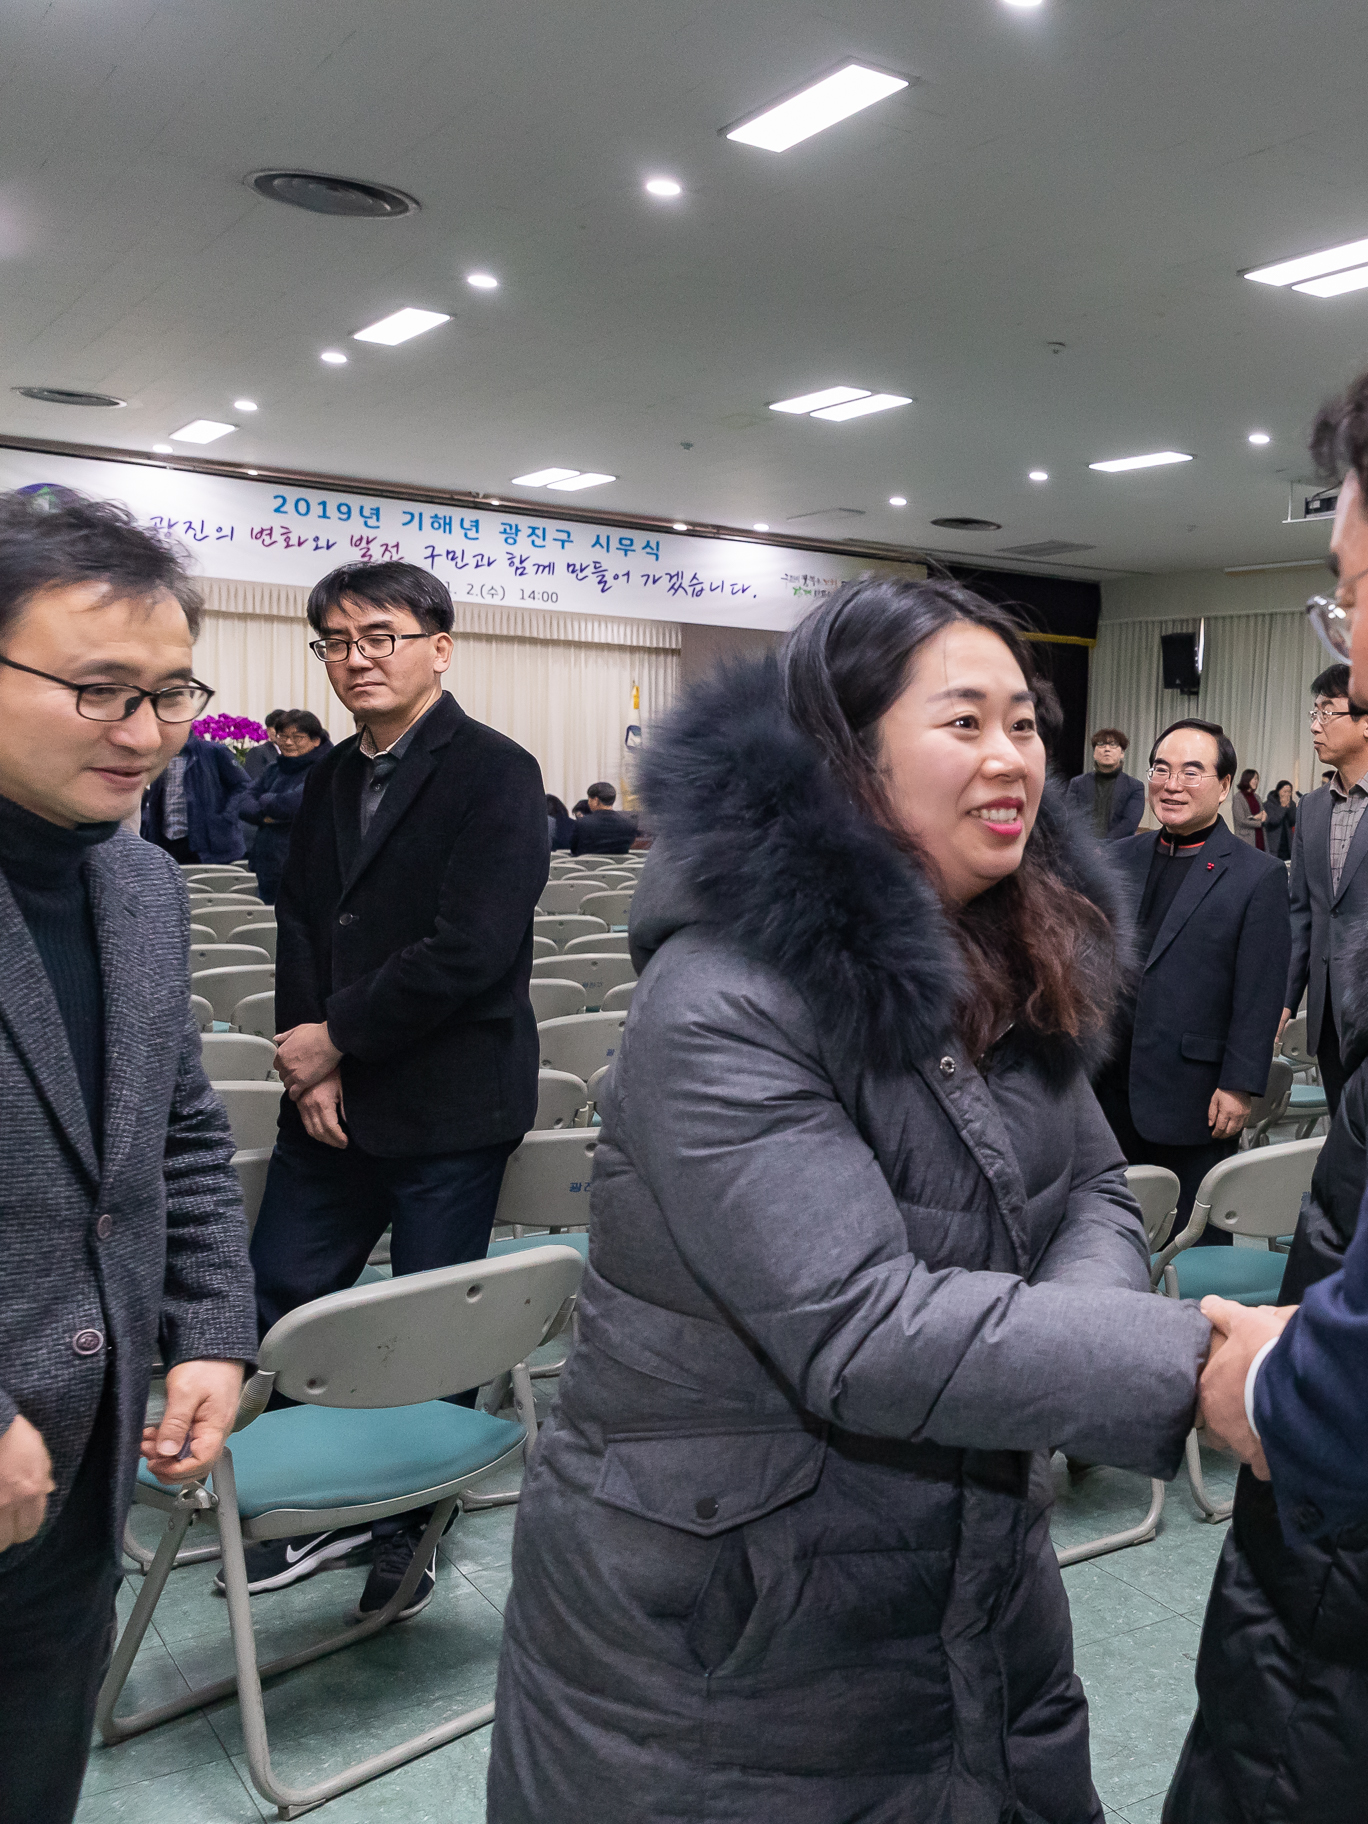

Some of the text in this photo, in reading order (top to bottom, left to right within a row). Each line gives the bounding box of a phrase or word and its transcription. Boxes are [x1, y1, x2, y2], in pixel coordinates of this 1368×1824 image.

[150, 516, 235, 541] 광진의
[250, 525, 337, 551] 변화와
[424, 545, 497, 570] 구민과
[506, 551, 555, 577] 함께
[566, 560, 630, 593] 만들어
[273, 494, 660, 561] 2019년 기해년 광진구 시무식
[519, 588, 559, 603] 14:00
